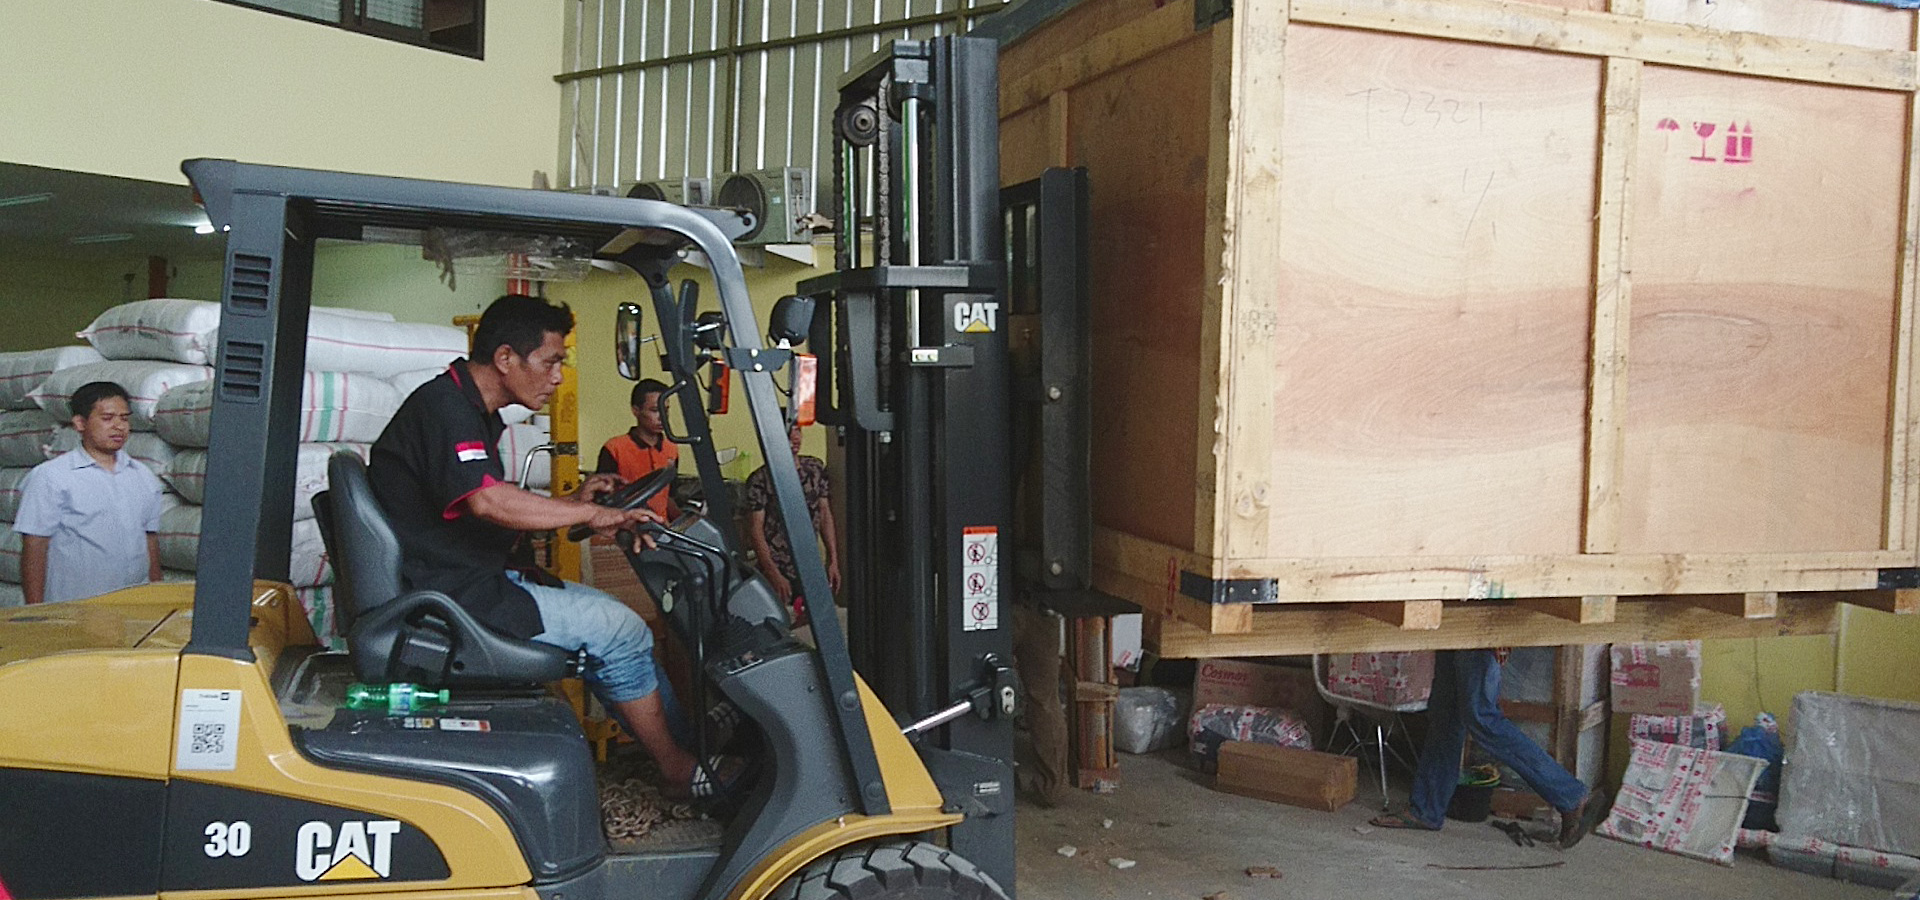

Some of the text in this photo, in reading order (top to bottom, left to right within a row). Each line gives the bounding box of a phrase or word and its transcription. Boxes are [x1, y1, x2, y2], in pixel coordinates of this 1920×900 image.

[954, 302, 999, 332] CAT
[204, 821, 251, 857] 30
[296, 820, 401, 881] CAT
